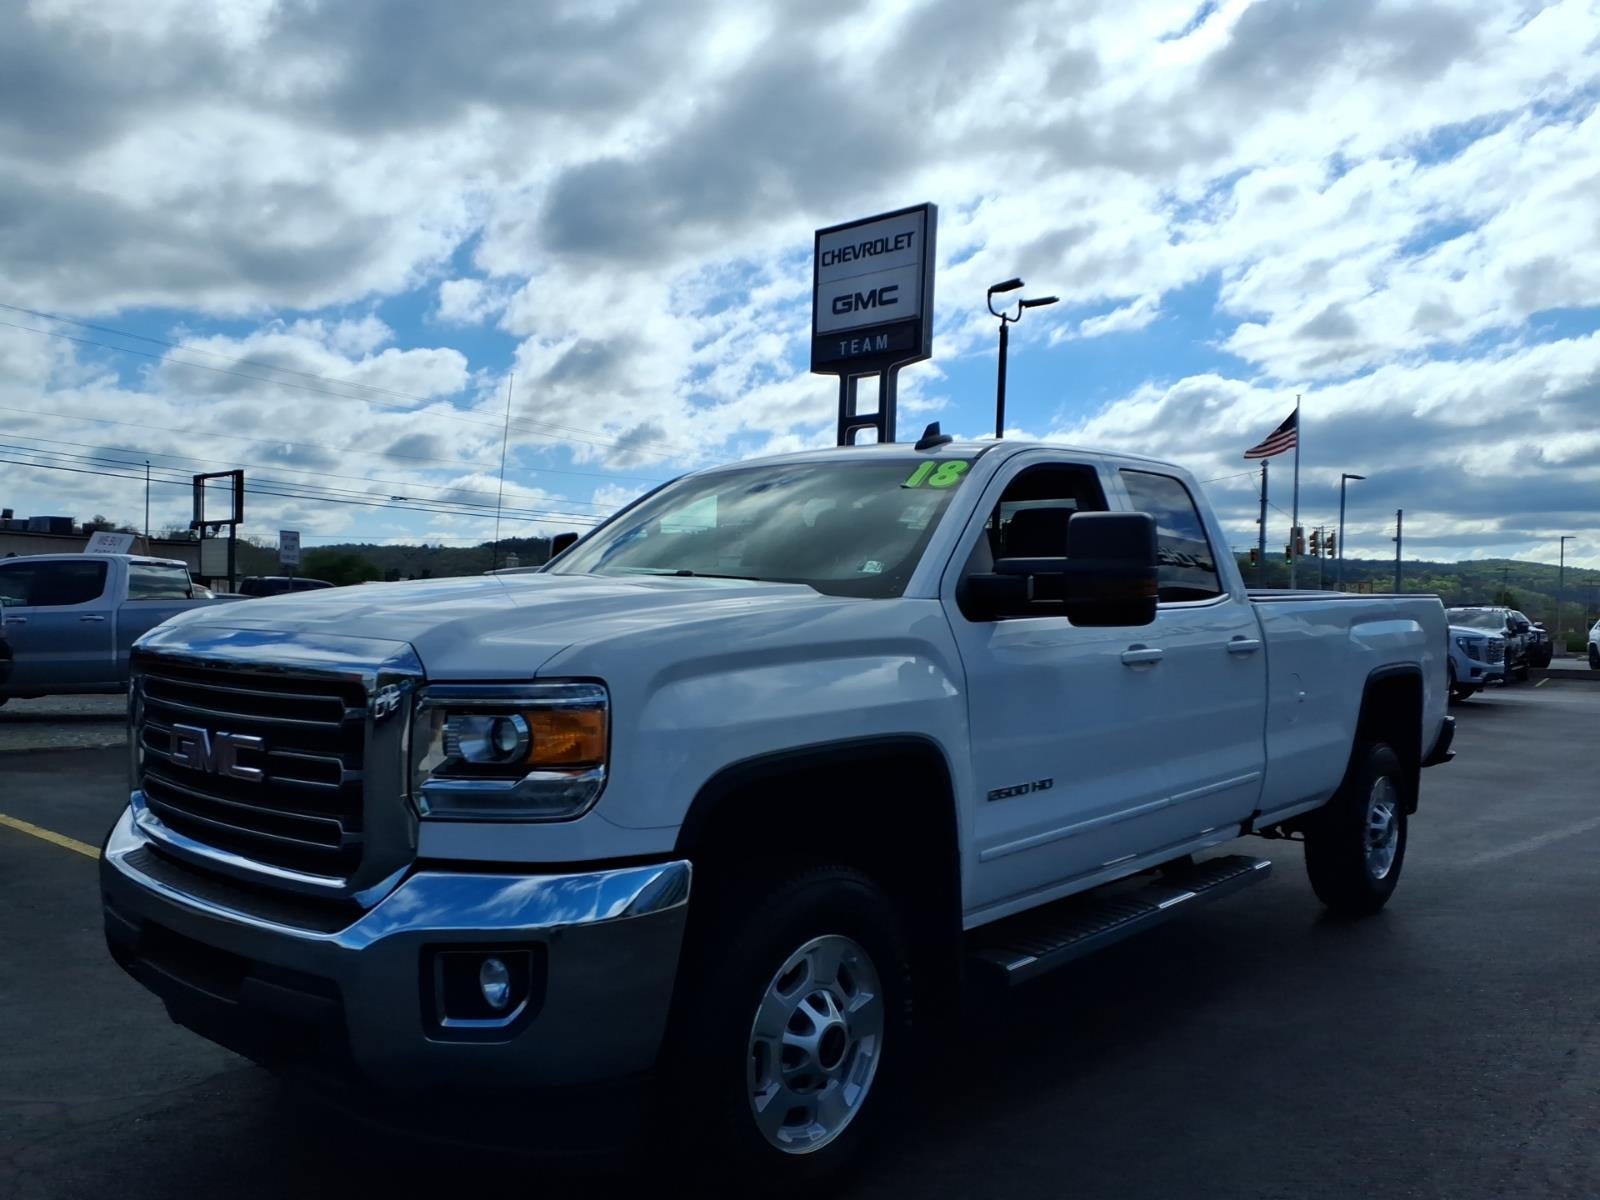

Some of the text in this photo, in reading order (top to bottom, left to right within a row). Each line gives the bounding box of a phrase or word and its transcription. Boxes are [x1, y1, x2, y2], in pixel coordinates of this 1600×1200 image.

[822, 231, 915, 267] CHEVROLET
[832, 284, 898, 315] GMC
[840, 334, 888, 356] TEAM
[903, 460, 969, 488] 18
[170, 723, 264, 782] GMC
[987, 778, 1053, 802] 2500 HD
